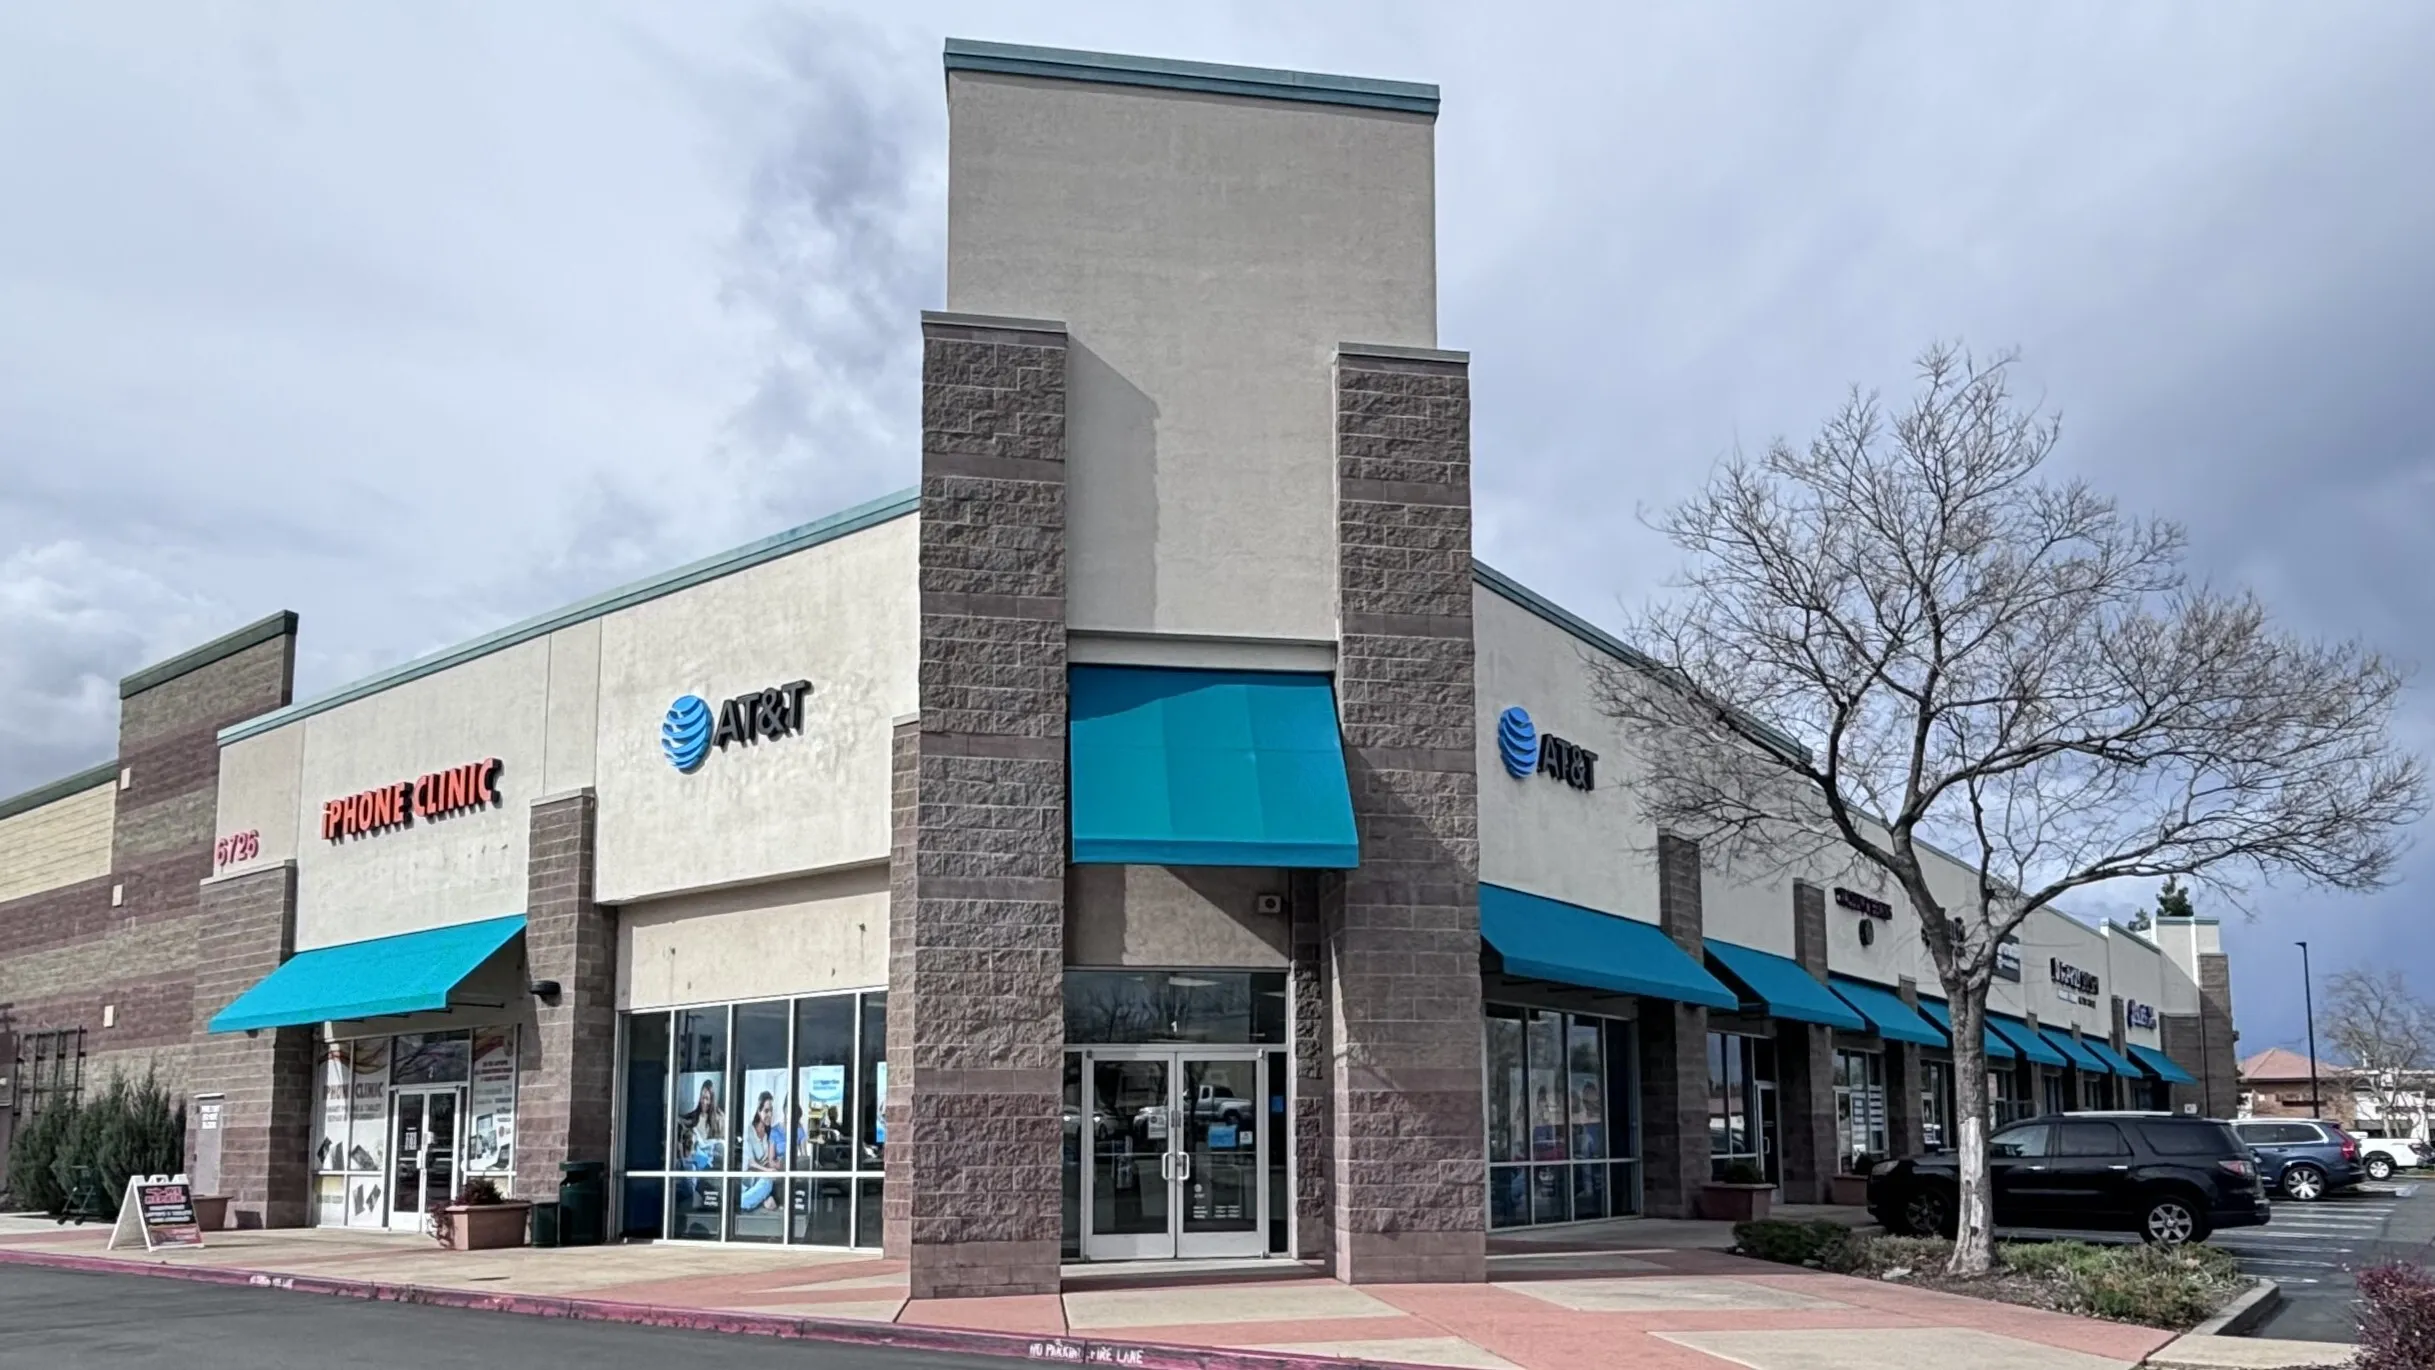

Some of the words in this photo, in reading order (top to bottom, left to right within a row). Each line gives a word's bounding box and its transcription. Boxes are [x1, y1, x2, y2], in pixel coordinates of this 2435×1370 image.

[712, 679, 813, 750] AT&T
[1537, 733, 1599, 792] AT&T
[321, 781, 412, 843] iPHONE
[412, 757, 503, 816] CLINIC
[217, 829, 260, 867] 6726
[1029, 1343, 1043, 1357] NO
[1116, 1349, 1145, 1364] LANE
